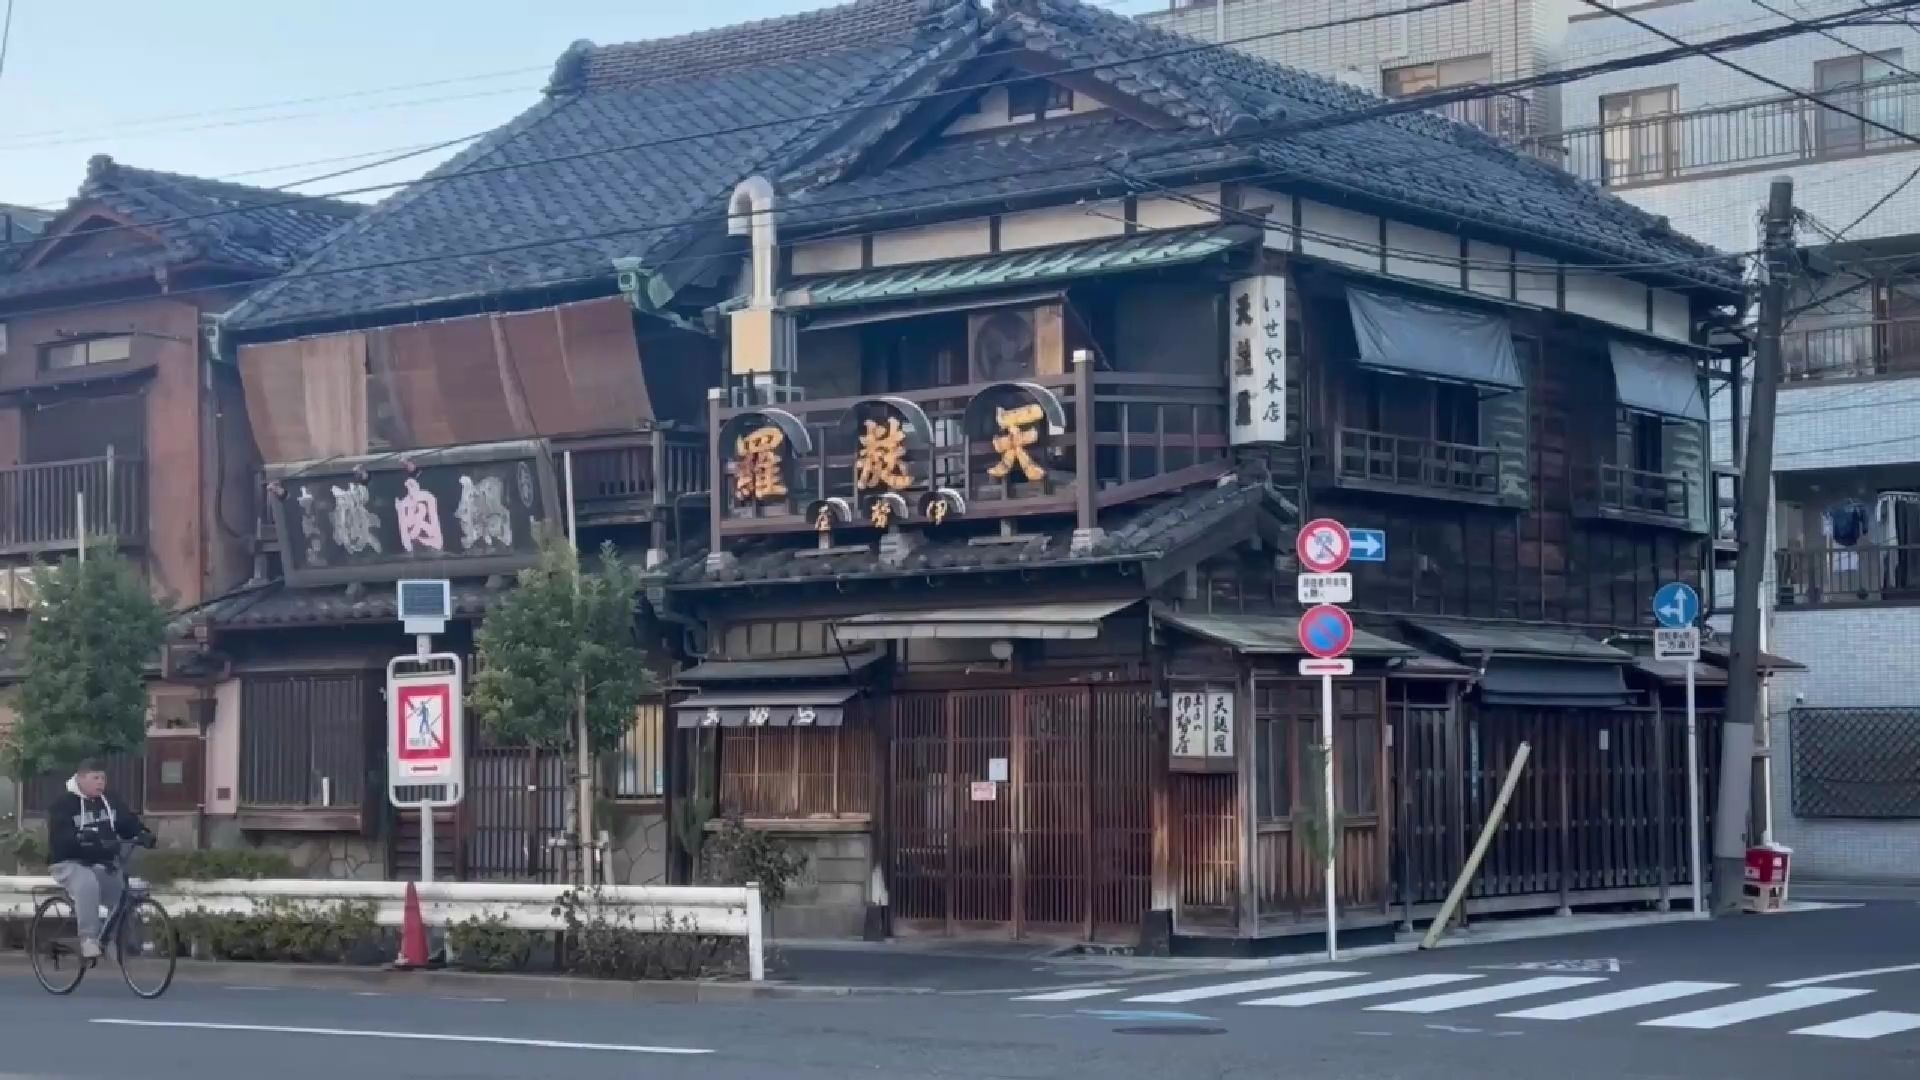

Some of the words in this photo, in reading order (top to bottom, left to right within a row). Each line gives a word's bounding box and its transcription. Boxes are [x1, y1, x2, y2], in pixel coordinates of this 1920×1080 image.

[1263, 295, 1283, 423] いせや本店
